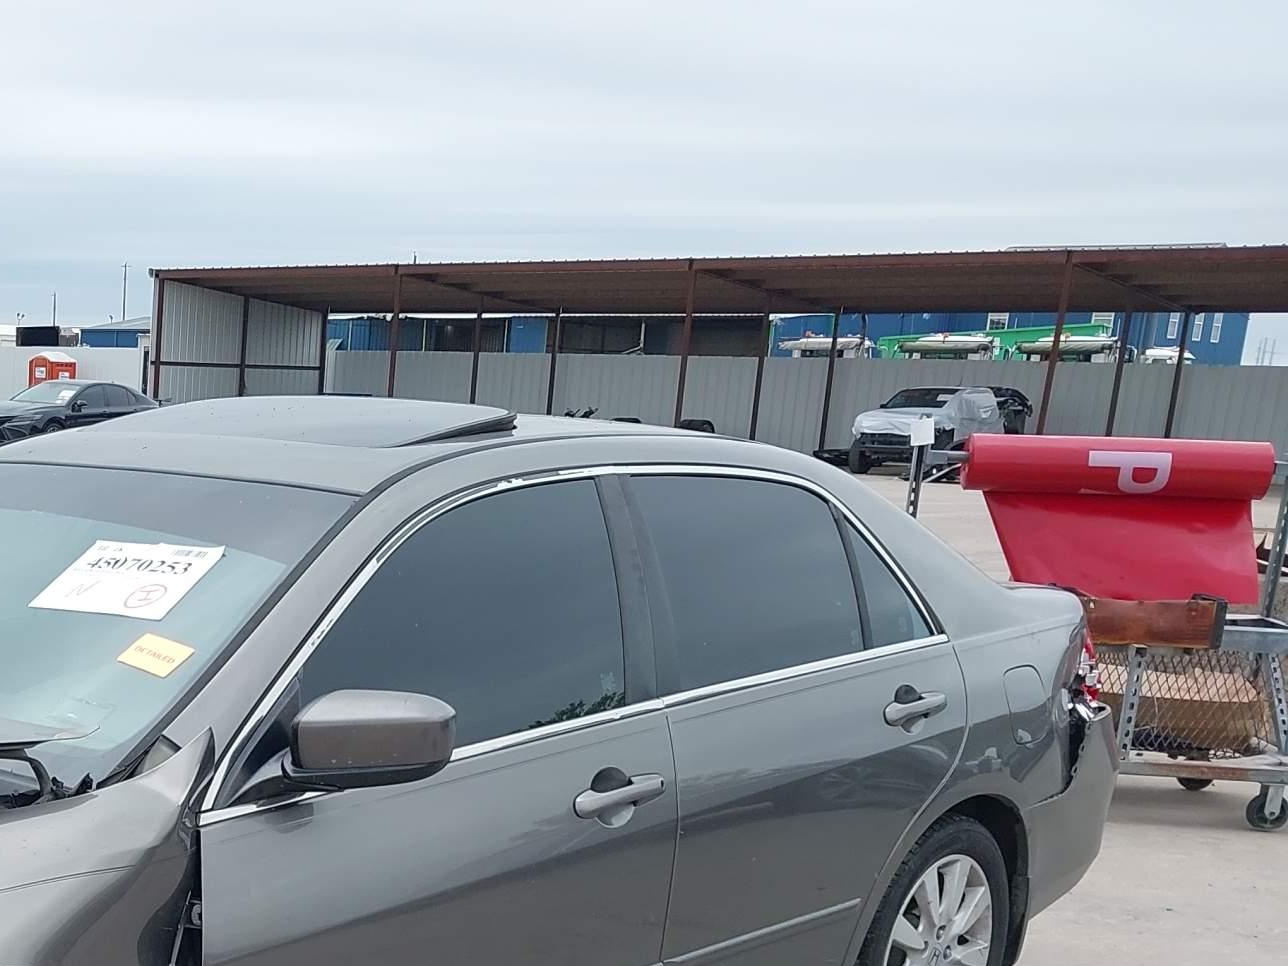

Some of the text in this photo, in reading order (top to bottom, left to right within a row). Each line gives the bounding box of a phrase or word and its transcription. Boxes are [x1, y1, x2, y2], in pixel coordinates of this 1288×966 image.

[1088, 450, 1172, 494] P
[88, 556, 193, 575] 45070253
[133, 645, 176, 664] DETAILED
